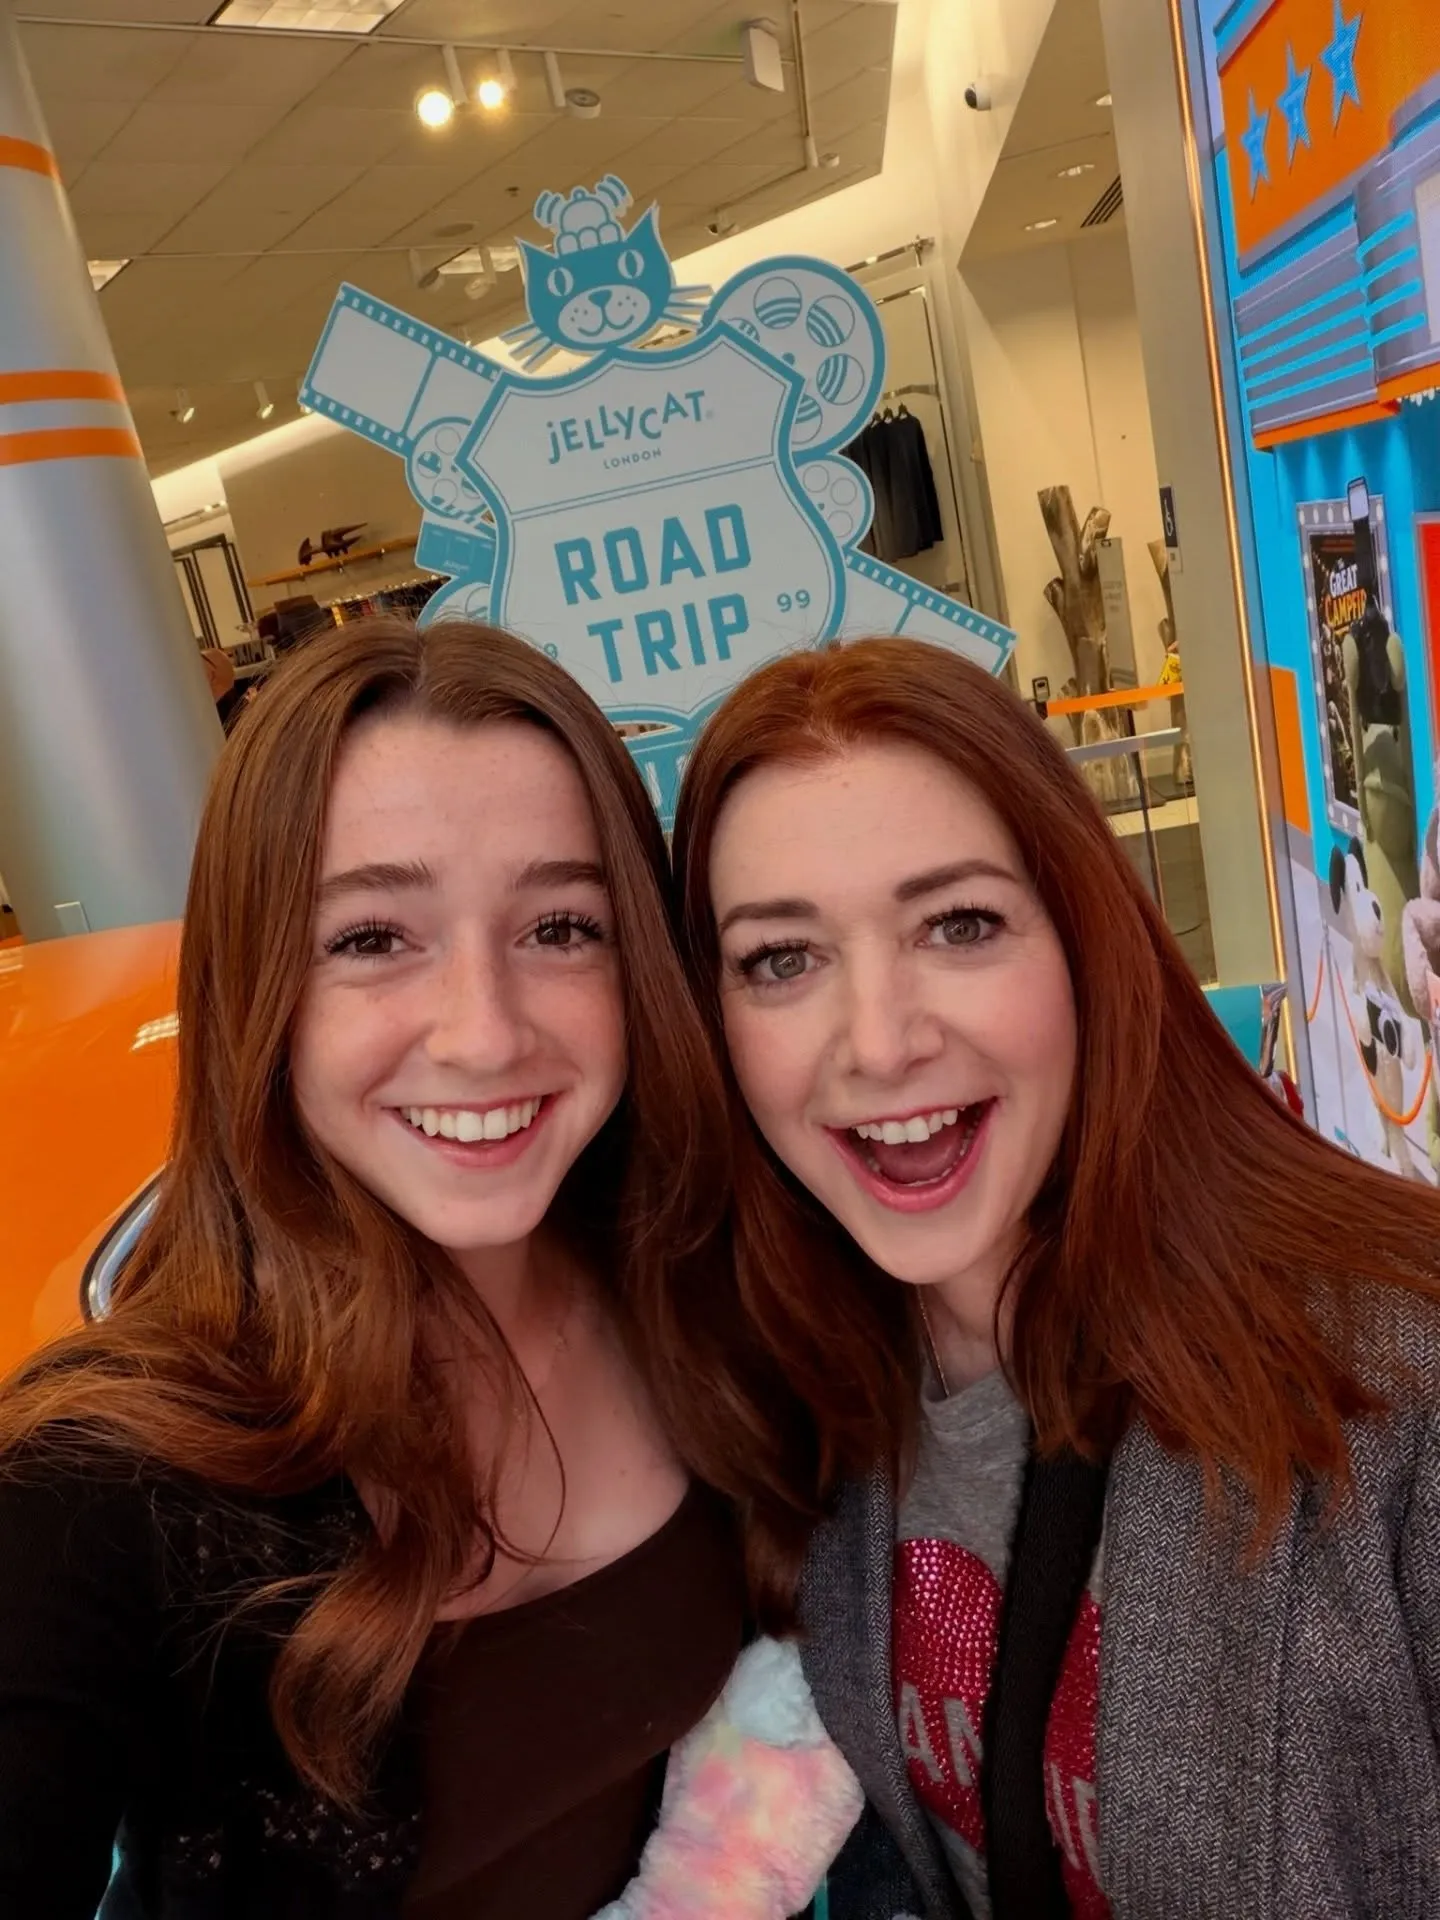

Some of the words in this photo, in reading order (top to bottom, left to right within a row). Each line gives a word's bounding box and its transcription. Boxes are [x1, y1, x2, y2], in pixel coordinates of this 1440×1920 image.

[603, 448, 662, 469] LONDON
[554, 503, 751, 605] ROAD
[1329, 563, 1358, 598] GREAT
[776, 589, 811, 612] 99
[587, 593, 749, 683] TRIP
